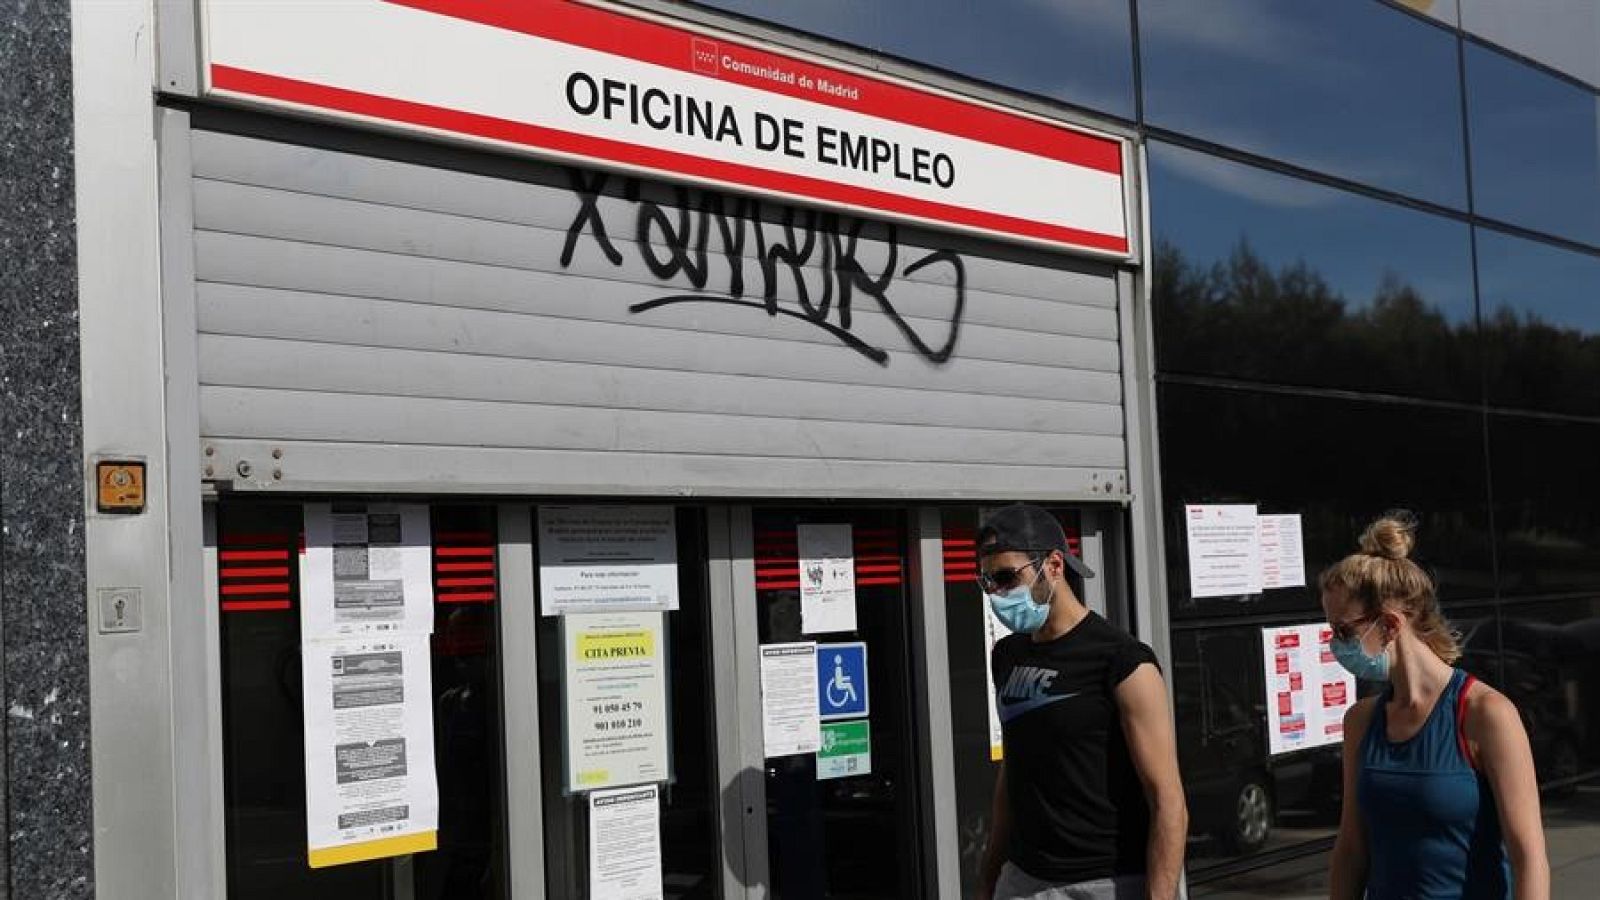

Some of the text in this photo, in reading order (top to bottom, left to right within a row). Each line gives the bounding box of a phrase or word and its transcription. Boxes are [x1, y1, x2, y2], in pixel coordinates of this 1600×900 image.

[721, 56, 860, 101] Comunidad de Madrid
[565, 70, 956, 190] OFICINA DE EMPLEO
[584, 645, 647, 659] CITA PREVIA
[1002, 666, 1058, 697] NIKE
